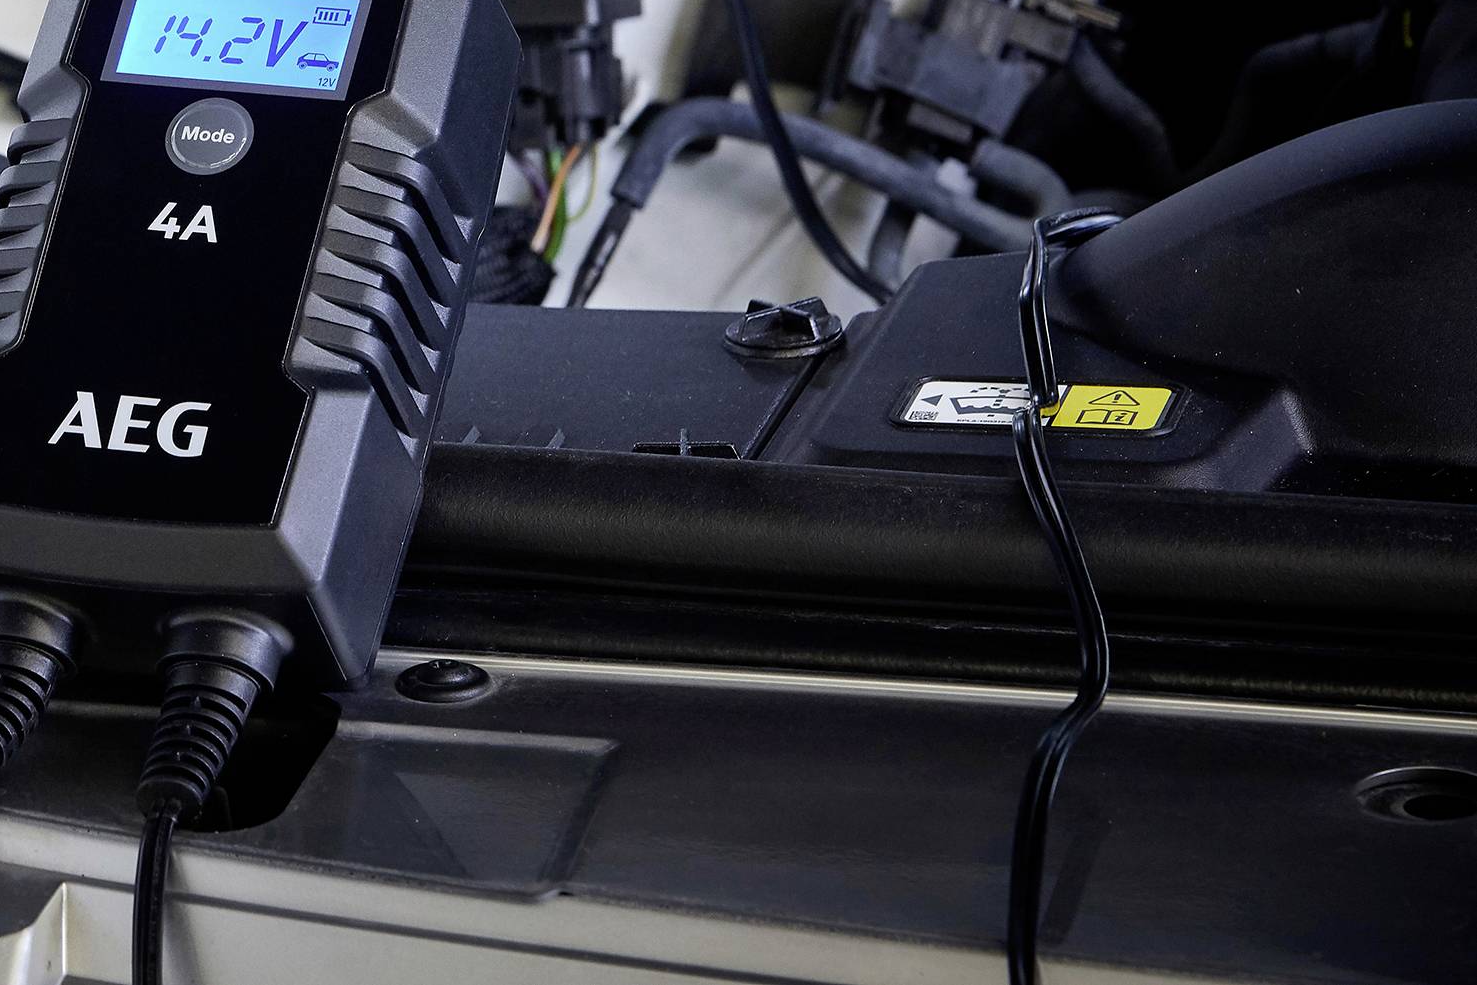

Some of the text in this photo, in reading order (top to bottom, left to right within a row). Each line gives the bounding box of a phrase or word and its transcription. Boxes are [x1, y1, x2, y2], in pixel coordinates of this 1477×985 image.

[154, 15, 309, 67] 14.2V
[318, 77, 336, 88] 12V
[181, 125, 235, 144] Mode
[147, 201, 218, 243] 4A
[47, 391, 212, 458] AEG
